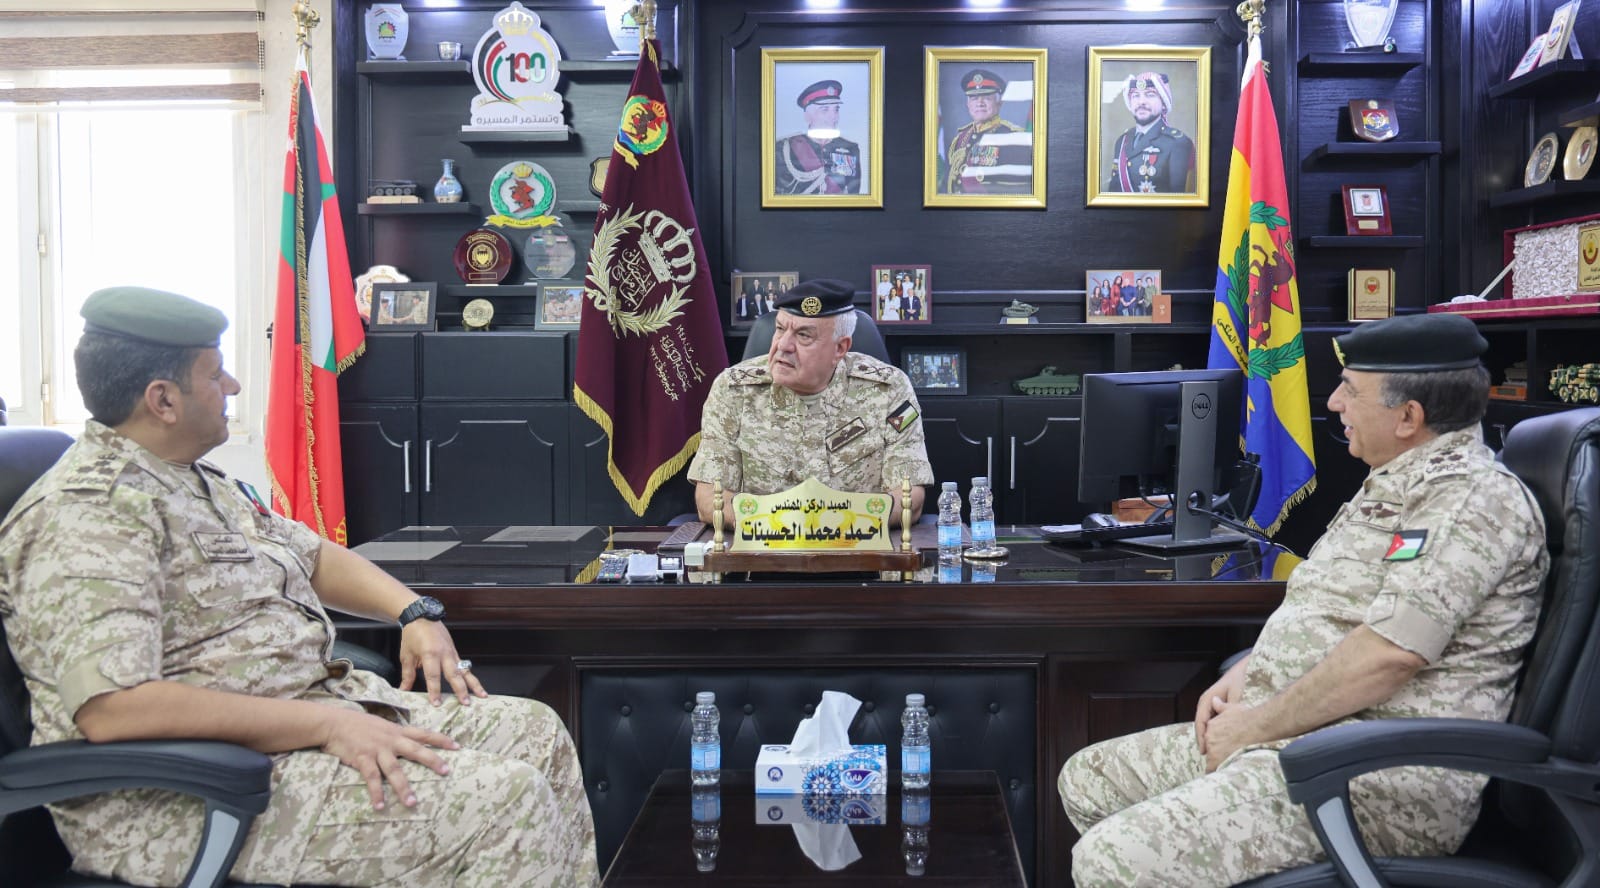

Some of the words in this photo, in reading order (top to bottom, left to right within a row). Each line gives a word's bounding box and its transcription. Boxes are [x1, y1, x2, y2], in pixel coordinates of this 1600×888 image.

[505, 52, 546, 83] 100
[520, 114, 559, 124] وتستمر
[771, 498, 802, 514] المهندس
[804, 498, 825, 513] الركن
[827, 499, 852, 513] العميد
[805, 522, 842, 541] محمد
[845, 517, 883, 540] أحمد
